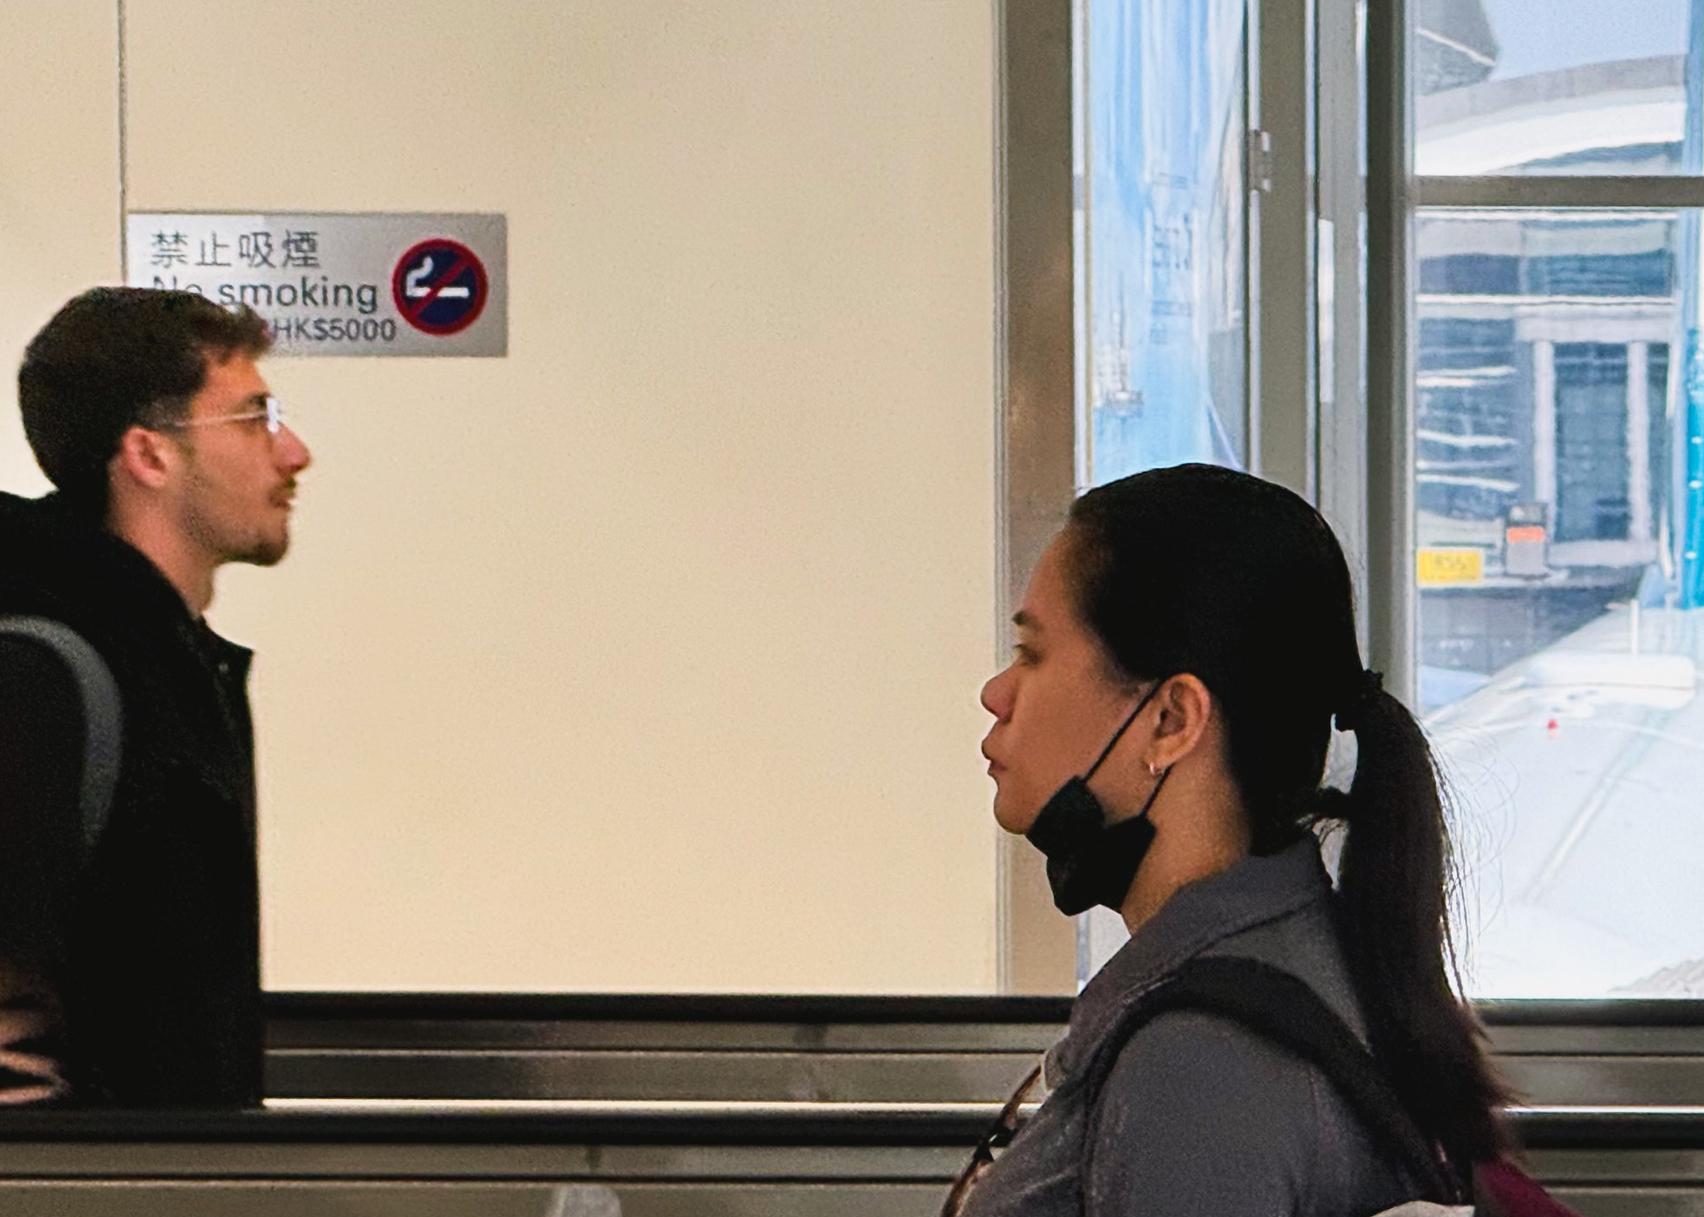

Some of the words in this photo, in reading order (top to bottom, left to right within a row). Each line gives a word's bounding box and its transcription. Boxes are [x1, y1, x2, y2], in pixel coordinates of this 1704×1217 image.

[152, 230, 319, 268] 禁止吸煙
[218, 276, 378, 313] smoking
